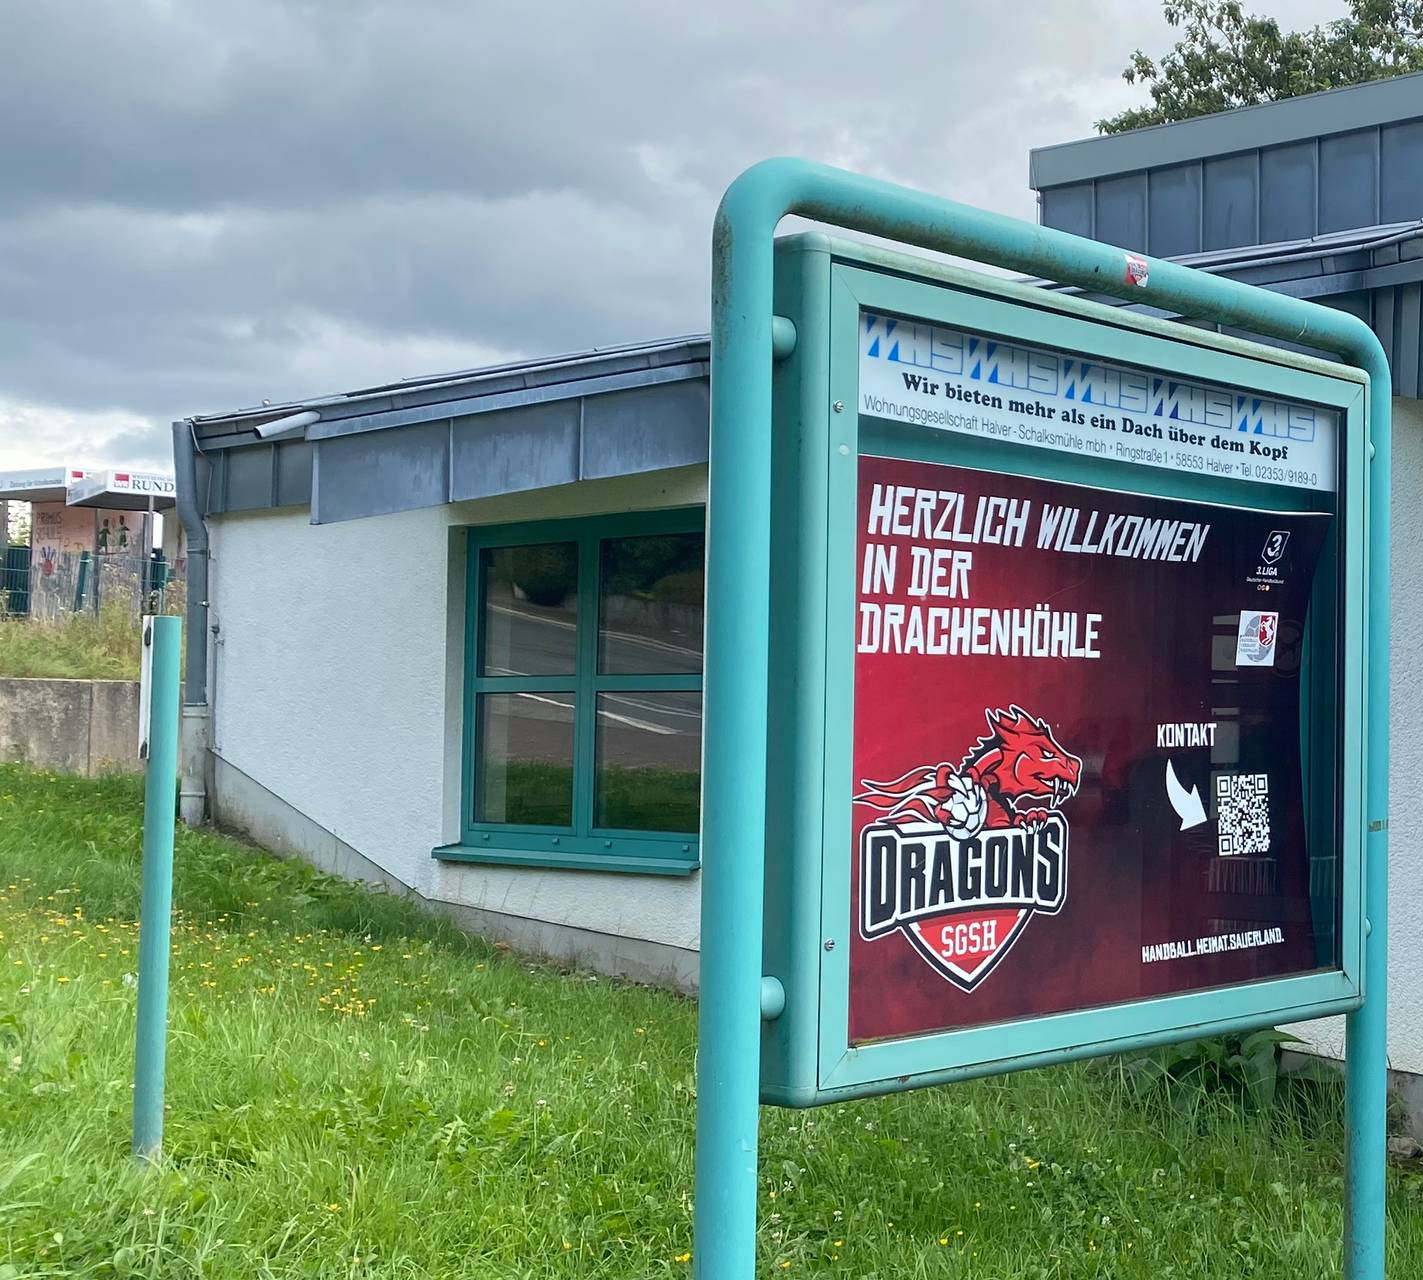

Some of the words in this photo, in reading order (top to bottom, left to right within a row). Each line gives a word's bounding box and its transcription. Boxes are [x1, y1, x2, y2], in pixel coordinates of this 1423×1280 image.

[864, 394, 979, 431] Wohnungsgesellschaft
[1085, 436, 1107, 451] mbh
[1175, 453, 1204, 470] 58553
[1206, 457, 1233, 474] Halver
[1240, 462, 1254, 477] Tel.
[1255, 465, 1318, 486] 02353/9189-0
[902, 372, 940, 396] Wir
[945, 383, 1003, 410] bieten
[1008, 399, 1056, 419] mehr
[1061, 408, 1086, 425] als
[1090, 414, 1116, 431] ein
[1121, 417, 1163, 439] Dach
[1168, 426, 1206, 447] über
[1210, 435, 1244, 453] dem
[1249, 440, 1289, 461] Kopf
[867, 483, 1031, 547] HERZLICH
[1036, 503, 1211, 562] WILLKOMMEN
[861, 543, 898, 595] IN
[907, 546, 973, 600] DER
[857, 602, 1103, 659] DRACHENHÖHLE
[1156, 723, 1217, 748] KONTAKT
[869, 817, 1062, 927] DRAGONS
[941, 919, 998, 958] SGSH
[1141, 927, 1285, 963] HANDBALL.HEIMAT.SAUERLAND.
